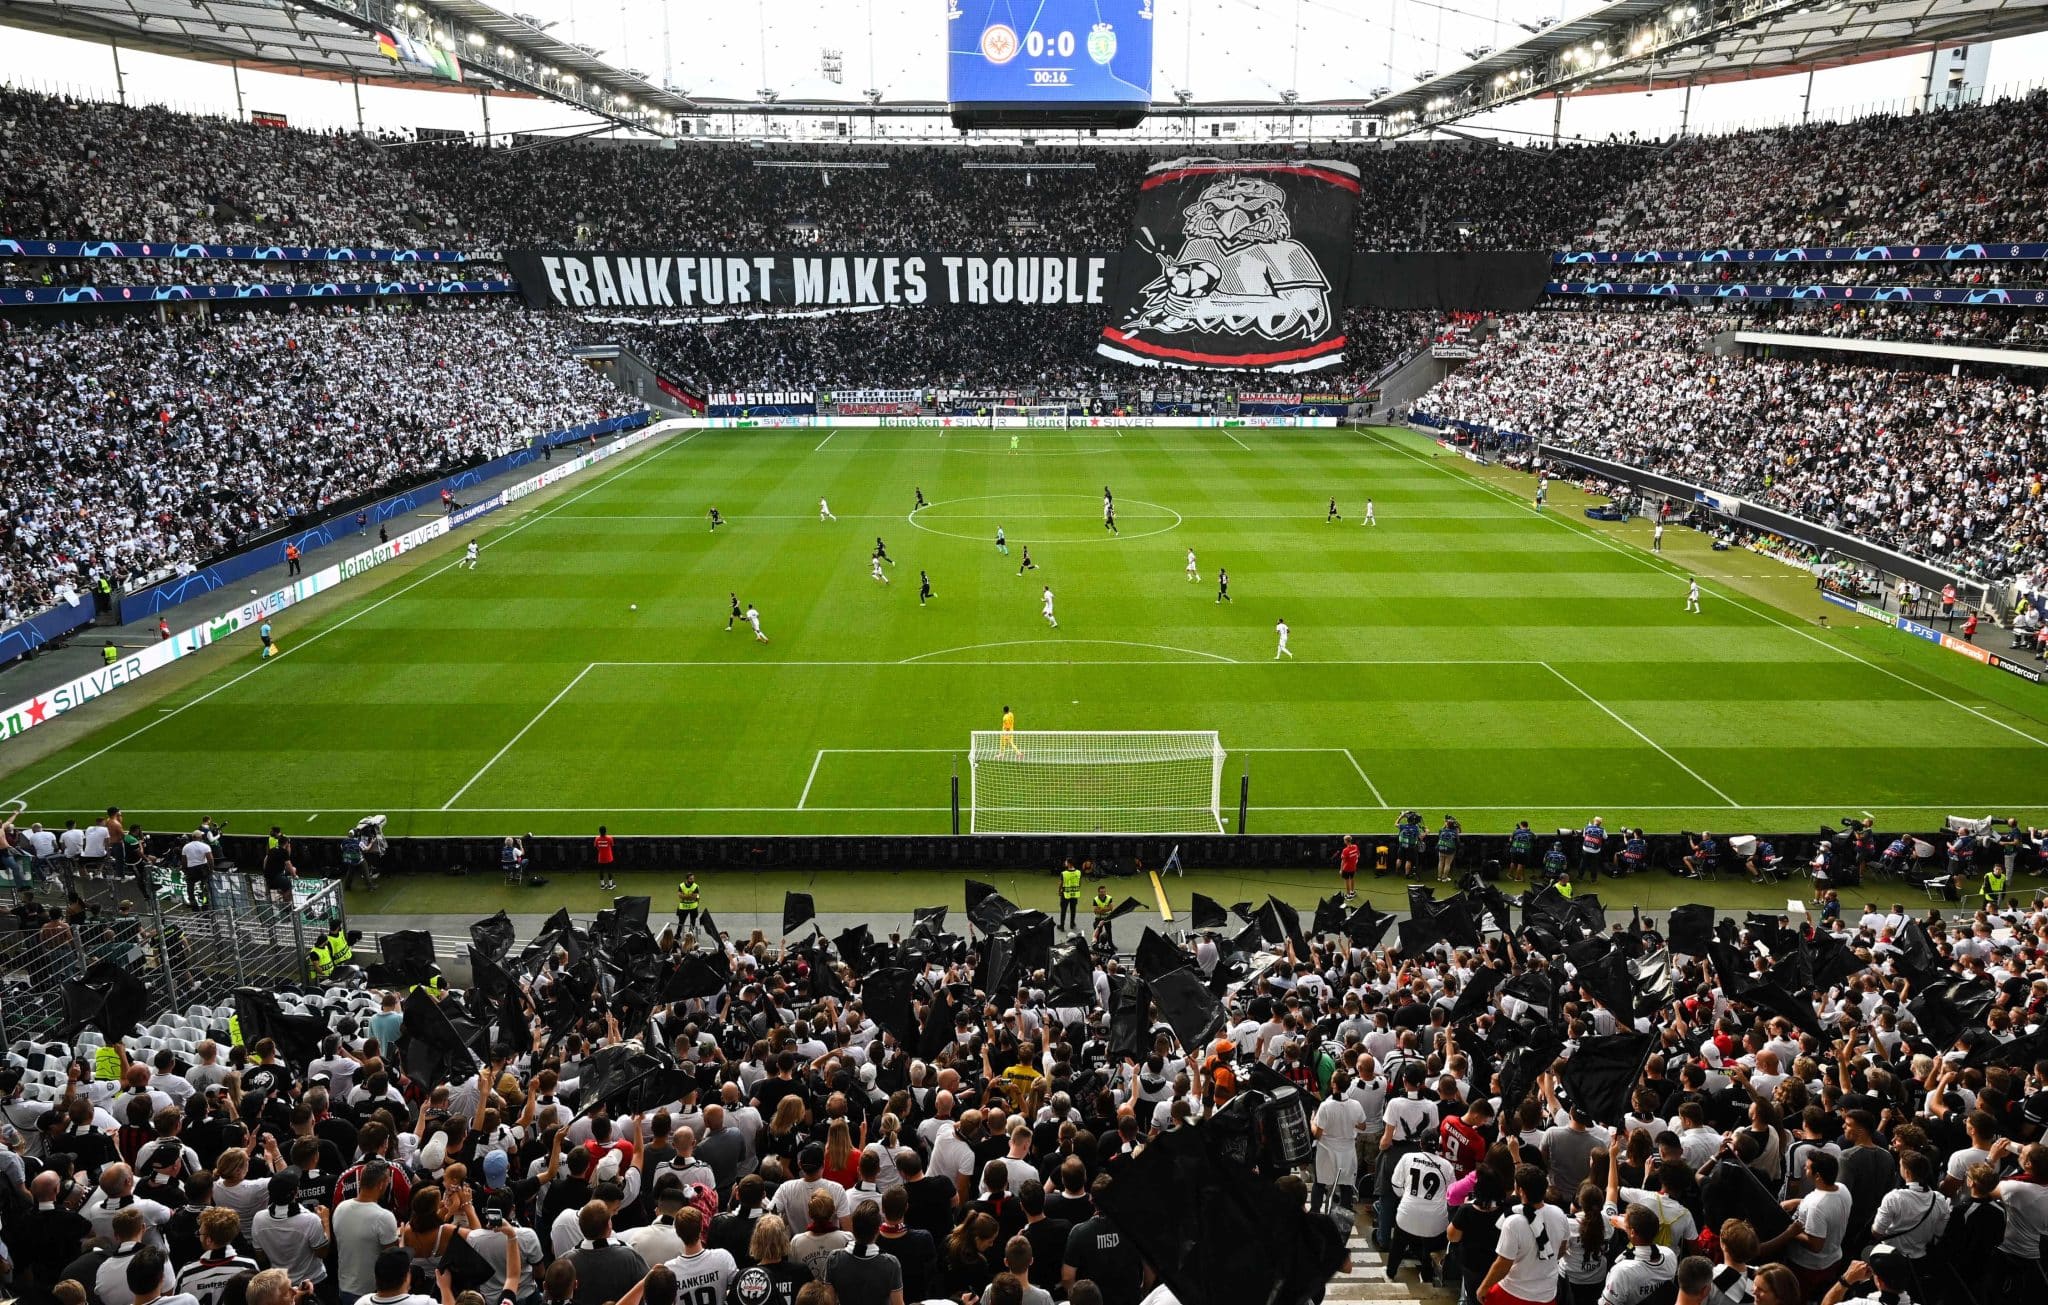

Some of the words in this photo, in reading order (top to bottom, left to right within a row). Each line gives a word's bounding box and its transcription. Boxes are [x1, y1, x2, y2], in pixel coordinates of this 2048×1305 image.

[1027, 30, 1075, 57] 0:0
[1034, 71, 1067, 84] 00:16
[541, 256, 774, 306] FRANKFURT
[792, 256, 927, 305] MAKES
[942, 256, 1106, 305] TROUBLE
[708, 391, 814, 405] WALDSTADION
[762, 417, 801, 425] SILVER
[879, 416, 940, 427] Heineken
[1104, 418, 1154, 427] SILVER
[1249, 417, 1287, 425] SILVER
[339, 546, 391, 581] Heineken
[403, 523, 440, 550] SILVER
[243, 590, 285, 621] SILVER
[1911, 625, 1934, 639] PS5
[2000, 660, 2040, 682] mastercard
[53, 657, 142, 713] SILVER
[1310, 984, 1319, 997] 9
[1444, 1123, 1470, 1146] FRANKFURT
[1445, 1135, 1461, 1162] 9
[1409, 1167, 1441, 1201] 19
[1097, 1232, 1120, 1250] MSD
[674, 1270, 720, 1290] RANKFURT
